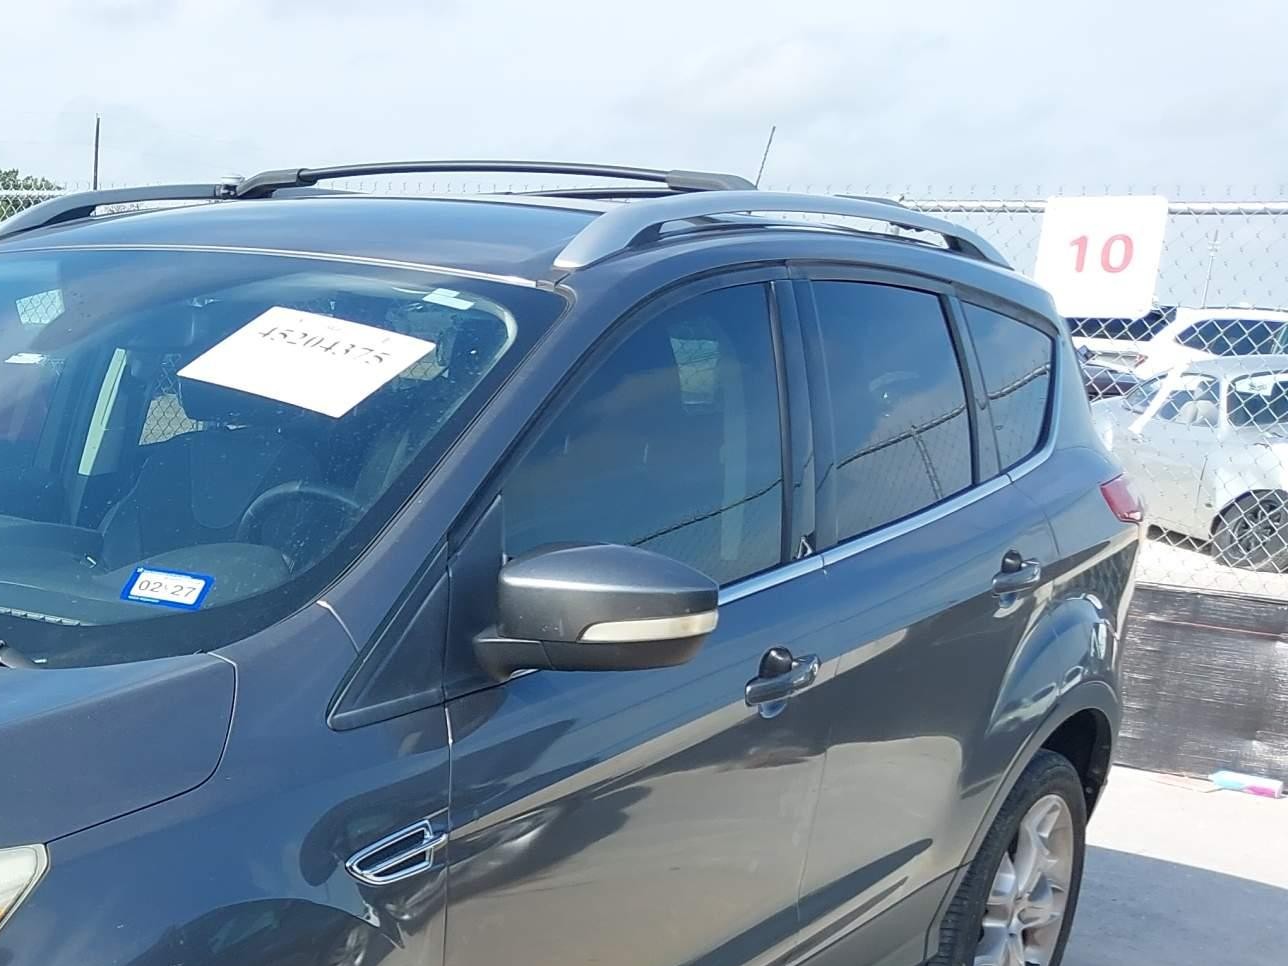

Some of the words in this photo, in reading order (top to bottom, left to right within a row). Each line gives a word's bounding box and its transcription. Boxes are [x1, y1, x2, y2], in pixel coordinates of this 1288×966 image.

[1069, 234, 1134, 273] 10
[258, 327, 391, 364] 45204375
[138, 580, 163, 593] 02
[170, 584, 197, 598] 27
